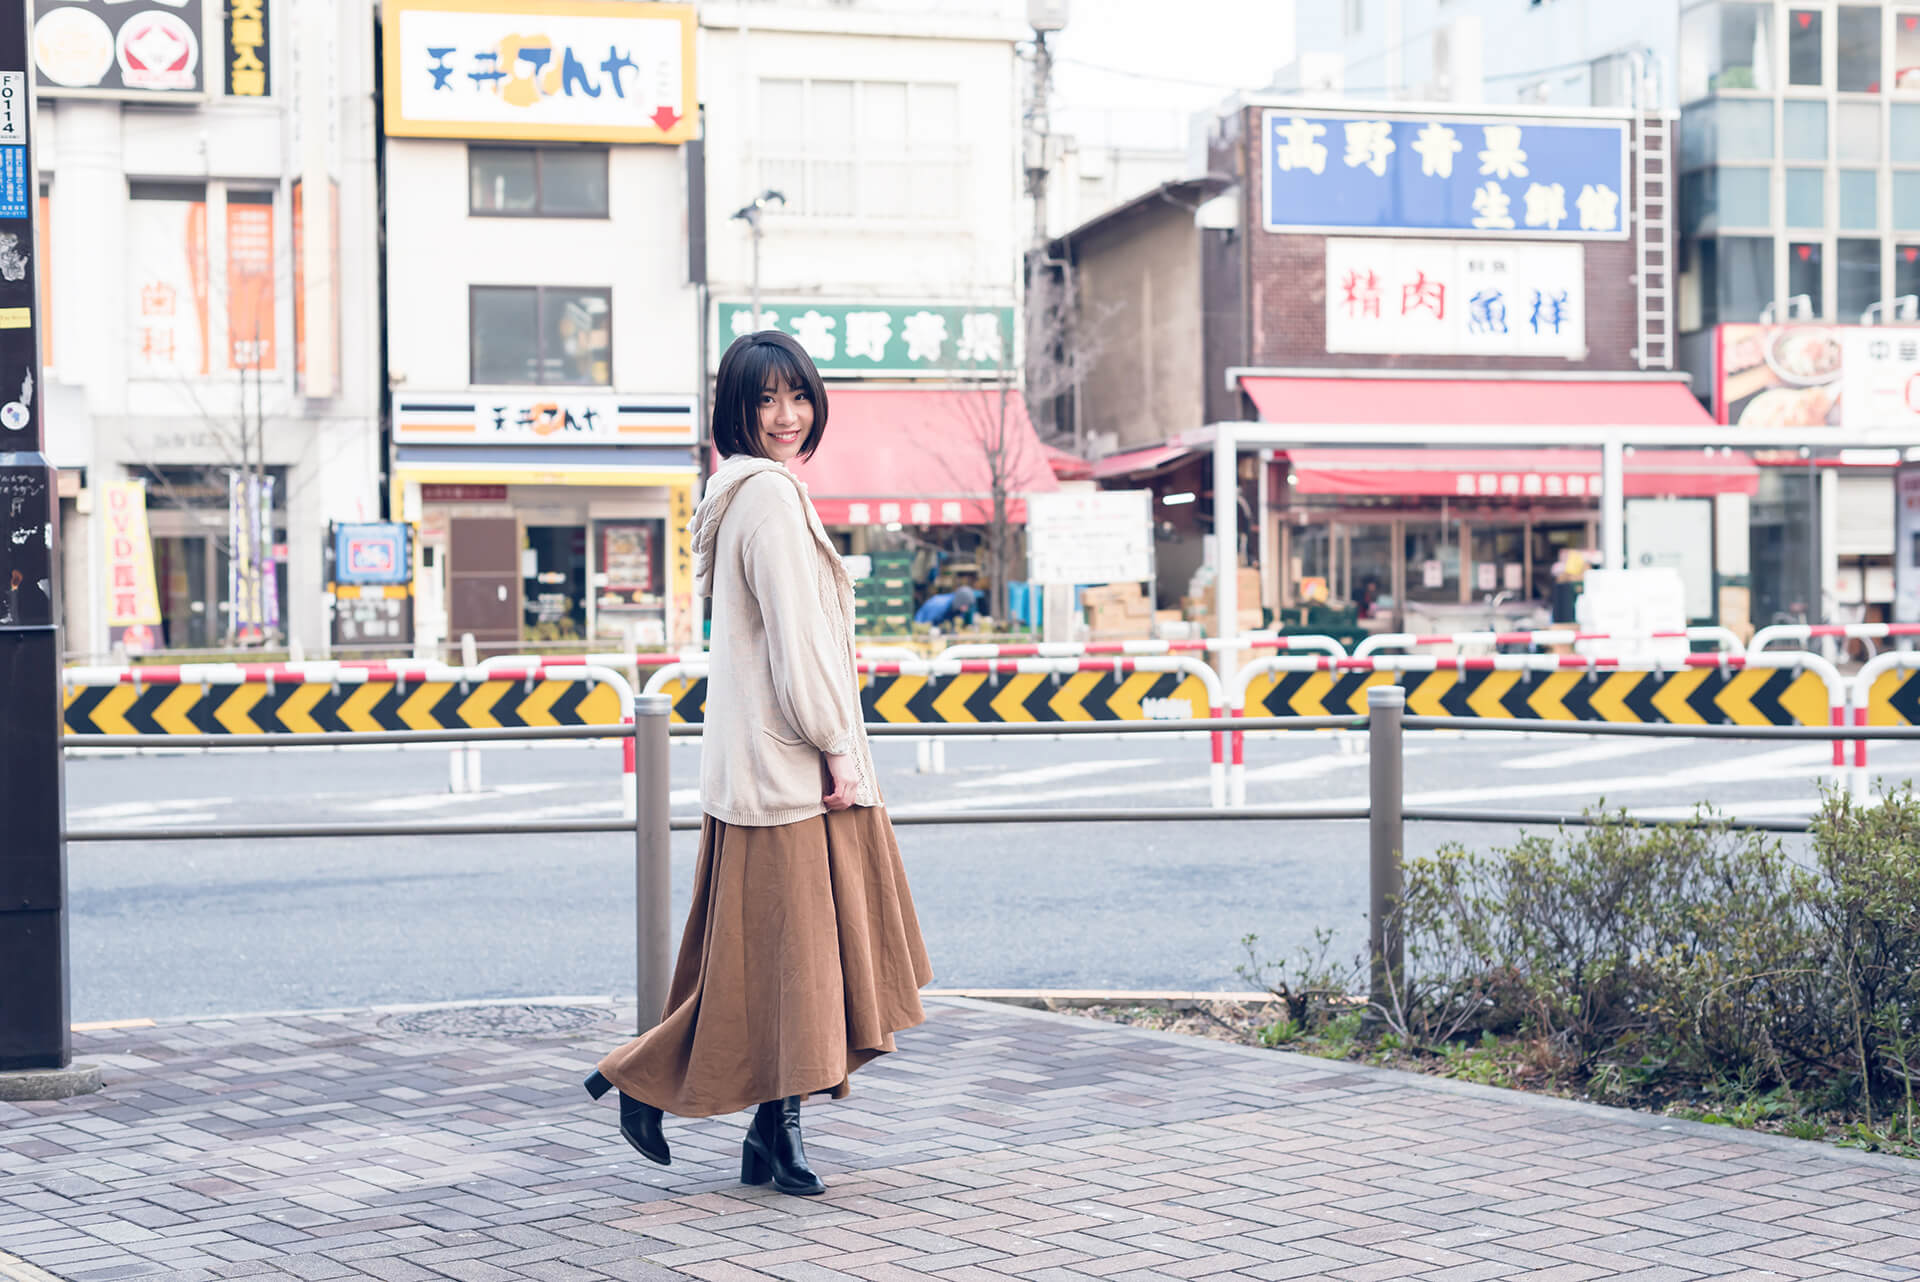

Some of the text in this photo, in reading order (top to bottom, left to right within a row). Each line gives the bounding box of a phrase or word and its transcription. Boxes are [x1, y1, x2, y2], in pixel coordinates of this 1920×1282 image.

[1274, 117, 1530, 181] 高野青果
[1340, 268, 1446, 320] 精肉
